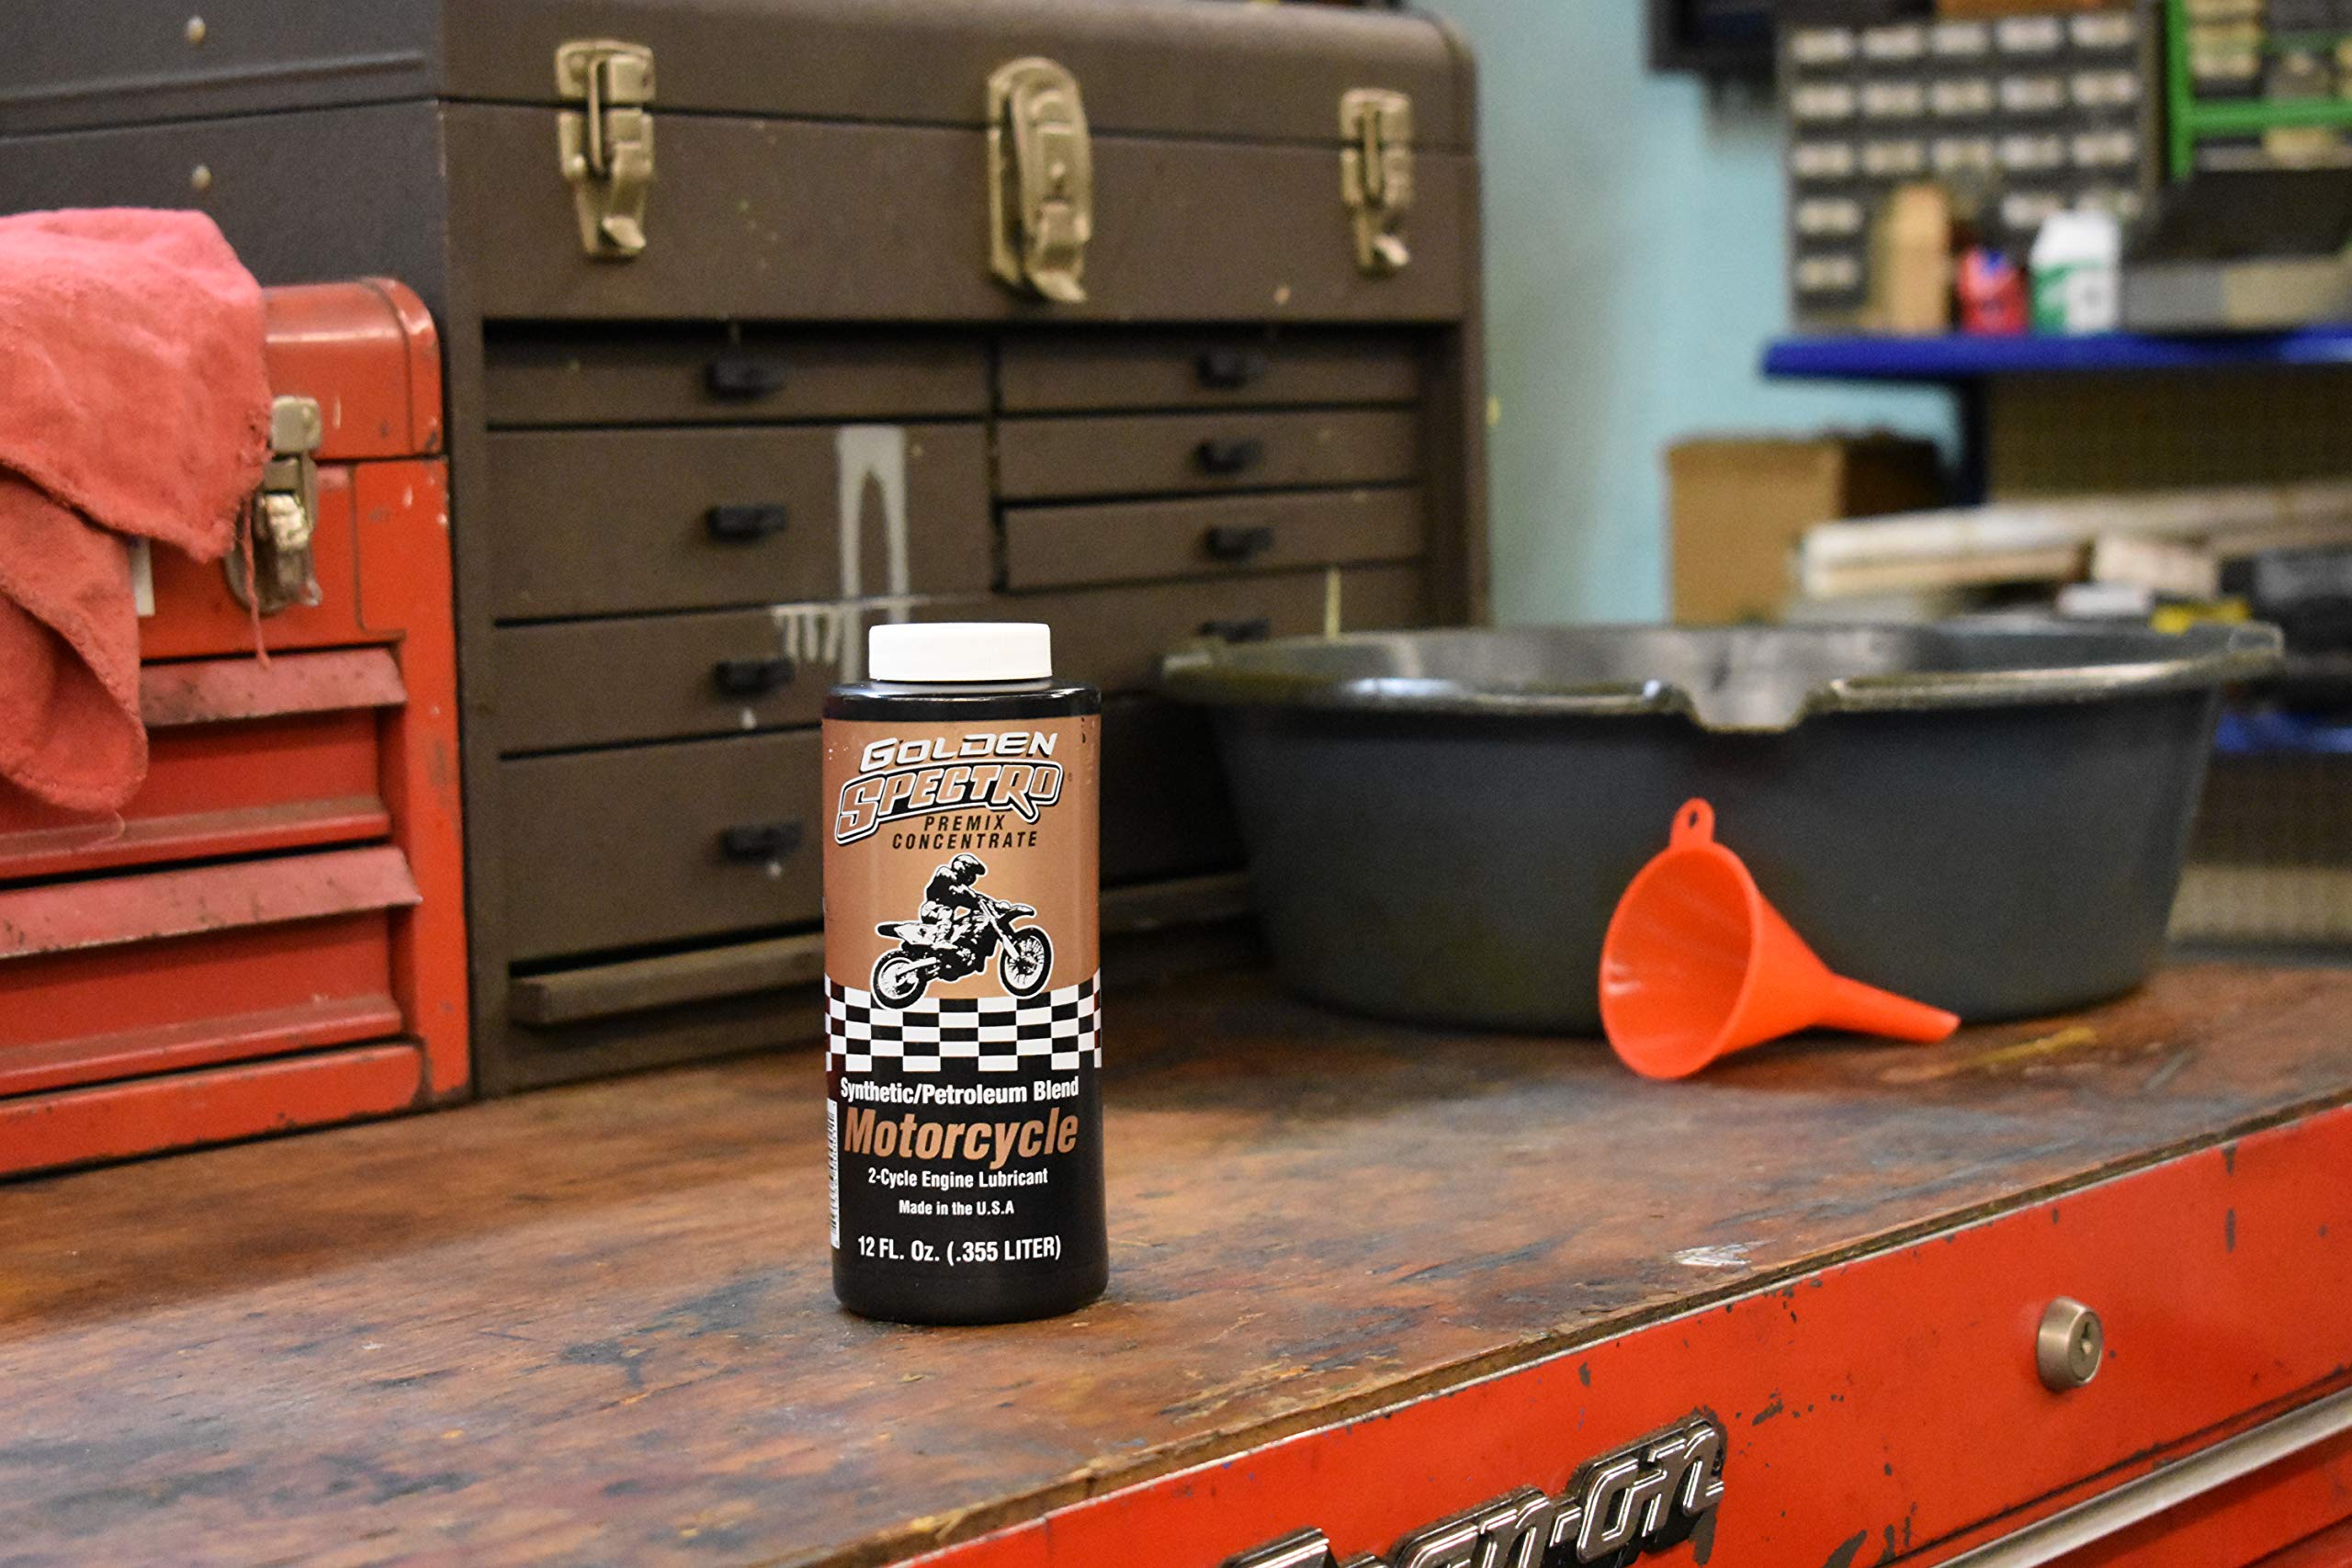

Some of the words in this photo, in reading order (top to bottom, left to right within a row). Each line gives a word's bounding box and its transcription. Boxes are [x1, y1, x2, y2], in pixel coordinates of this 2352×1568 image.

[835, 759, 1064, 846] SPECTRO
[923, 814, 1006, 832] PREMIX
[891, 830, 1038, 850] CONCENTRATE
[840, 1077, 1027, 1105] Synthetic/Petroleum
[1033, 1076, 1080, 1100] Blend
[843, 1106, 1080, 1170] Motorcycle
[867, 1167, 918, 1188] 2-Cycle
[921, 1170, 974, 1191] Engine
[978, 1168, 1048, 1188] Lubricant
[899, 1200, 933, 1215] Made
[935, 1201, 948, 1215] in
[951, 1201, 973, 1216] the
[976, 1201, 1015, 1215] U.S.A
[857, 1235, 876, 1258] 12
[878, 1238, 905, 1260] FL.
[910, 1240, 940, 1262] Oz.
[946, 1240, 999, 1267] (.355
[1003, 1235, 1062, 1261] LITER)
